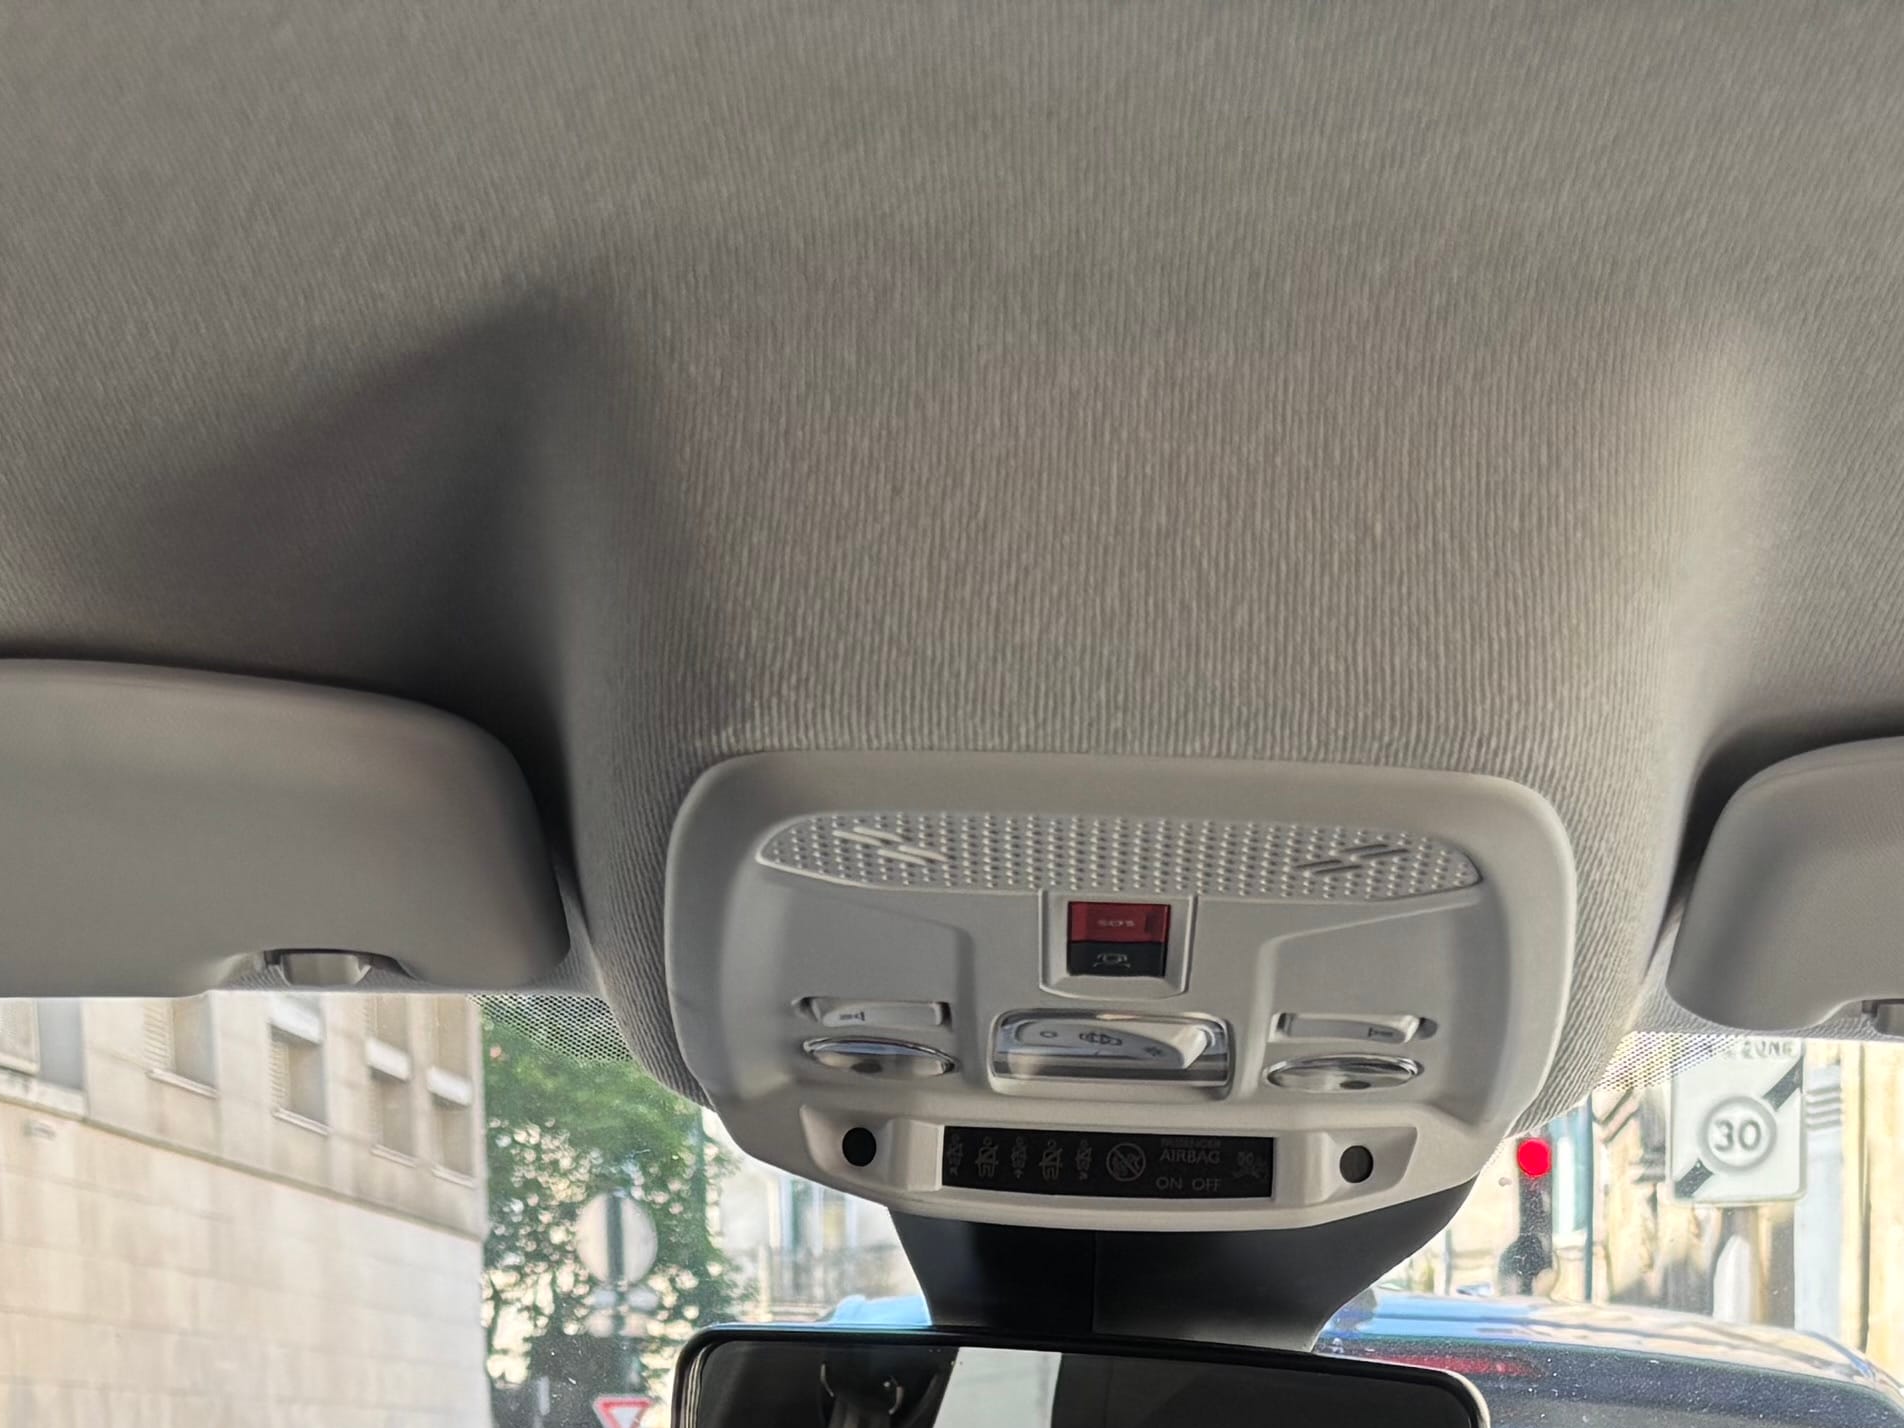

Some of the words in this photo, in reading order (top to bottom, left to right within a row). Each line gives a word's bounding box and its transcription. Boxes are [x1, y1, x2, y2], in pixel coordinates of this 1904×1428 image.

[1713, 1118, 1763, 1152] 30
[1159, 1149, 1221, 1165] AIRBAG
[1155, 1176, 1183, 1191] ON
[1191, 1177, 1222, 1192] OFF
